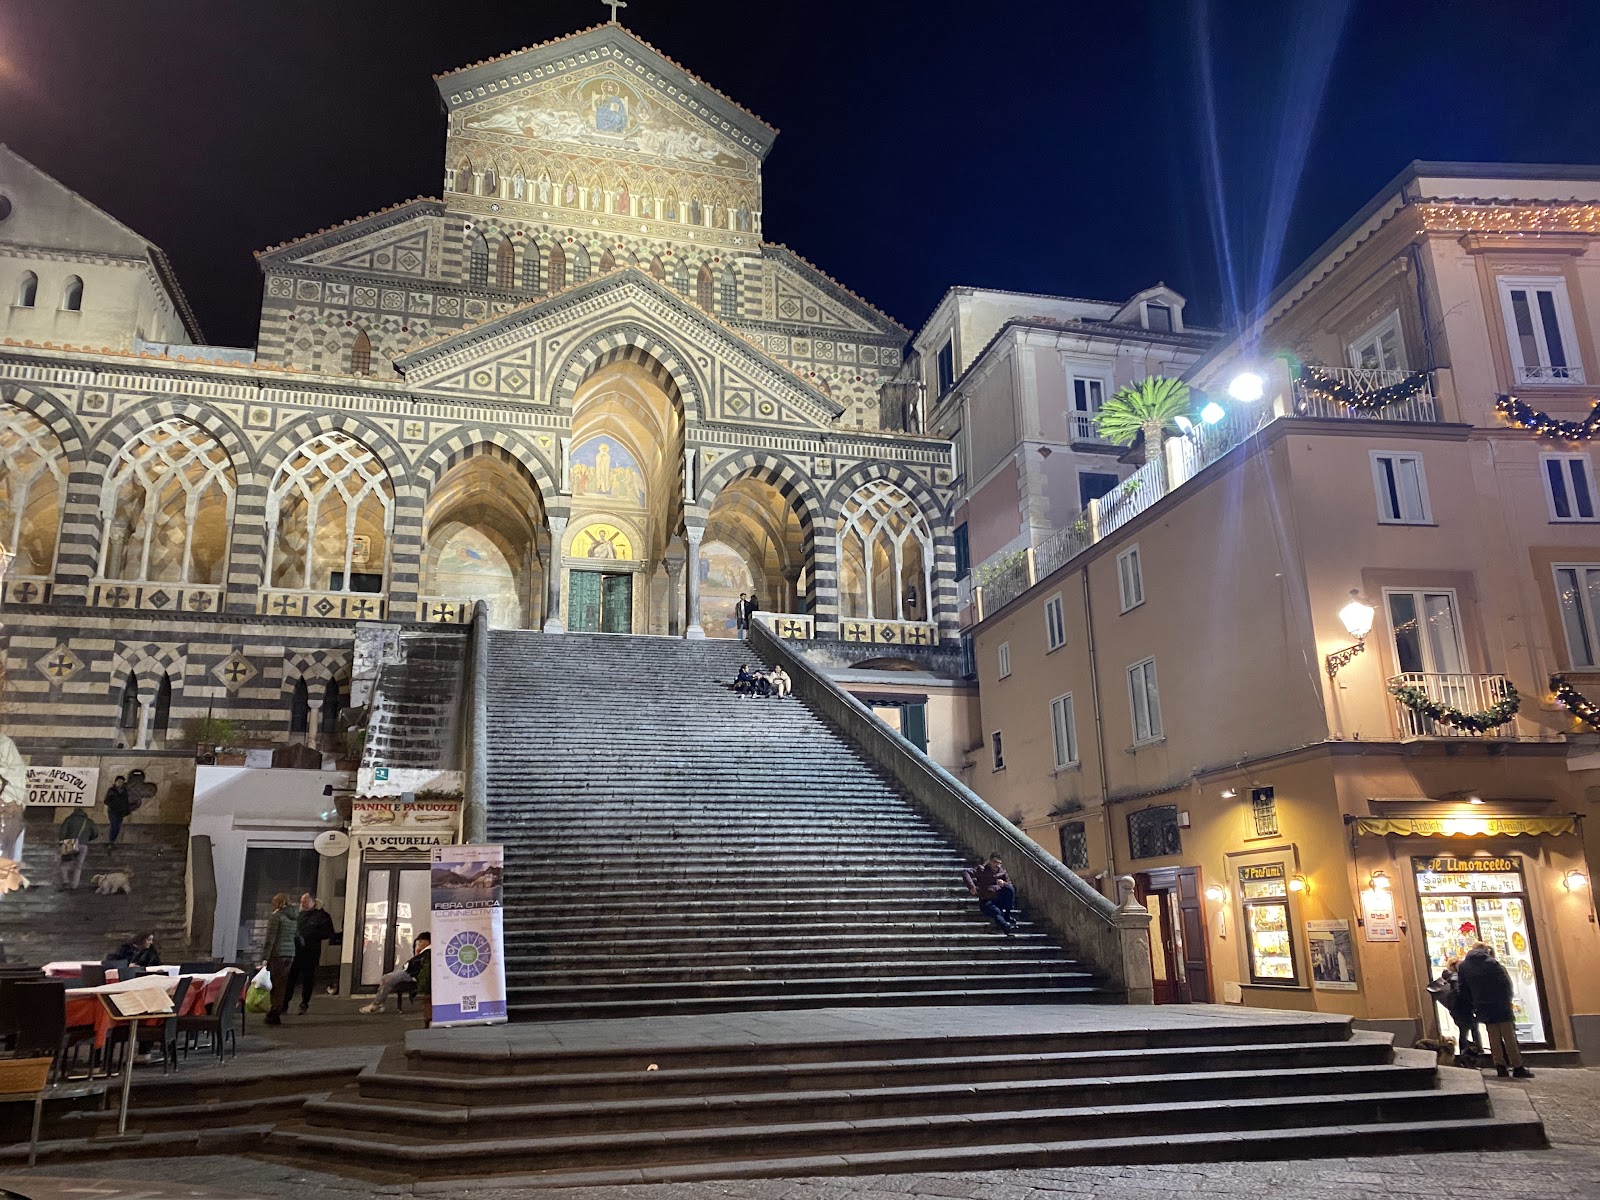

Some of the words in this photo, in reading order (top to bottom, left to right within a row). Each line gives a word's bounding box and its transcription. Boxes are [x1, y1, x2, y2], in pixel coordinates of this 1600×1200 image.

[49, 769, 87, 790] APOSTOLI
[353, 803, 392, 811] PANINI
[403, 804, 458, 812] PANUOZZI
[1410, 819, 1444, 832] Antich
[1488, 819, 1526, 831] d'Amalfi
[380, 837, 440, 845] SCIURELLA
[1251, 867, 1280, 879] Profumi
[1471, 880, 1515, 891] d'Amalfi
[466, 900, 500, 908] OTTICA
